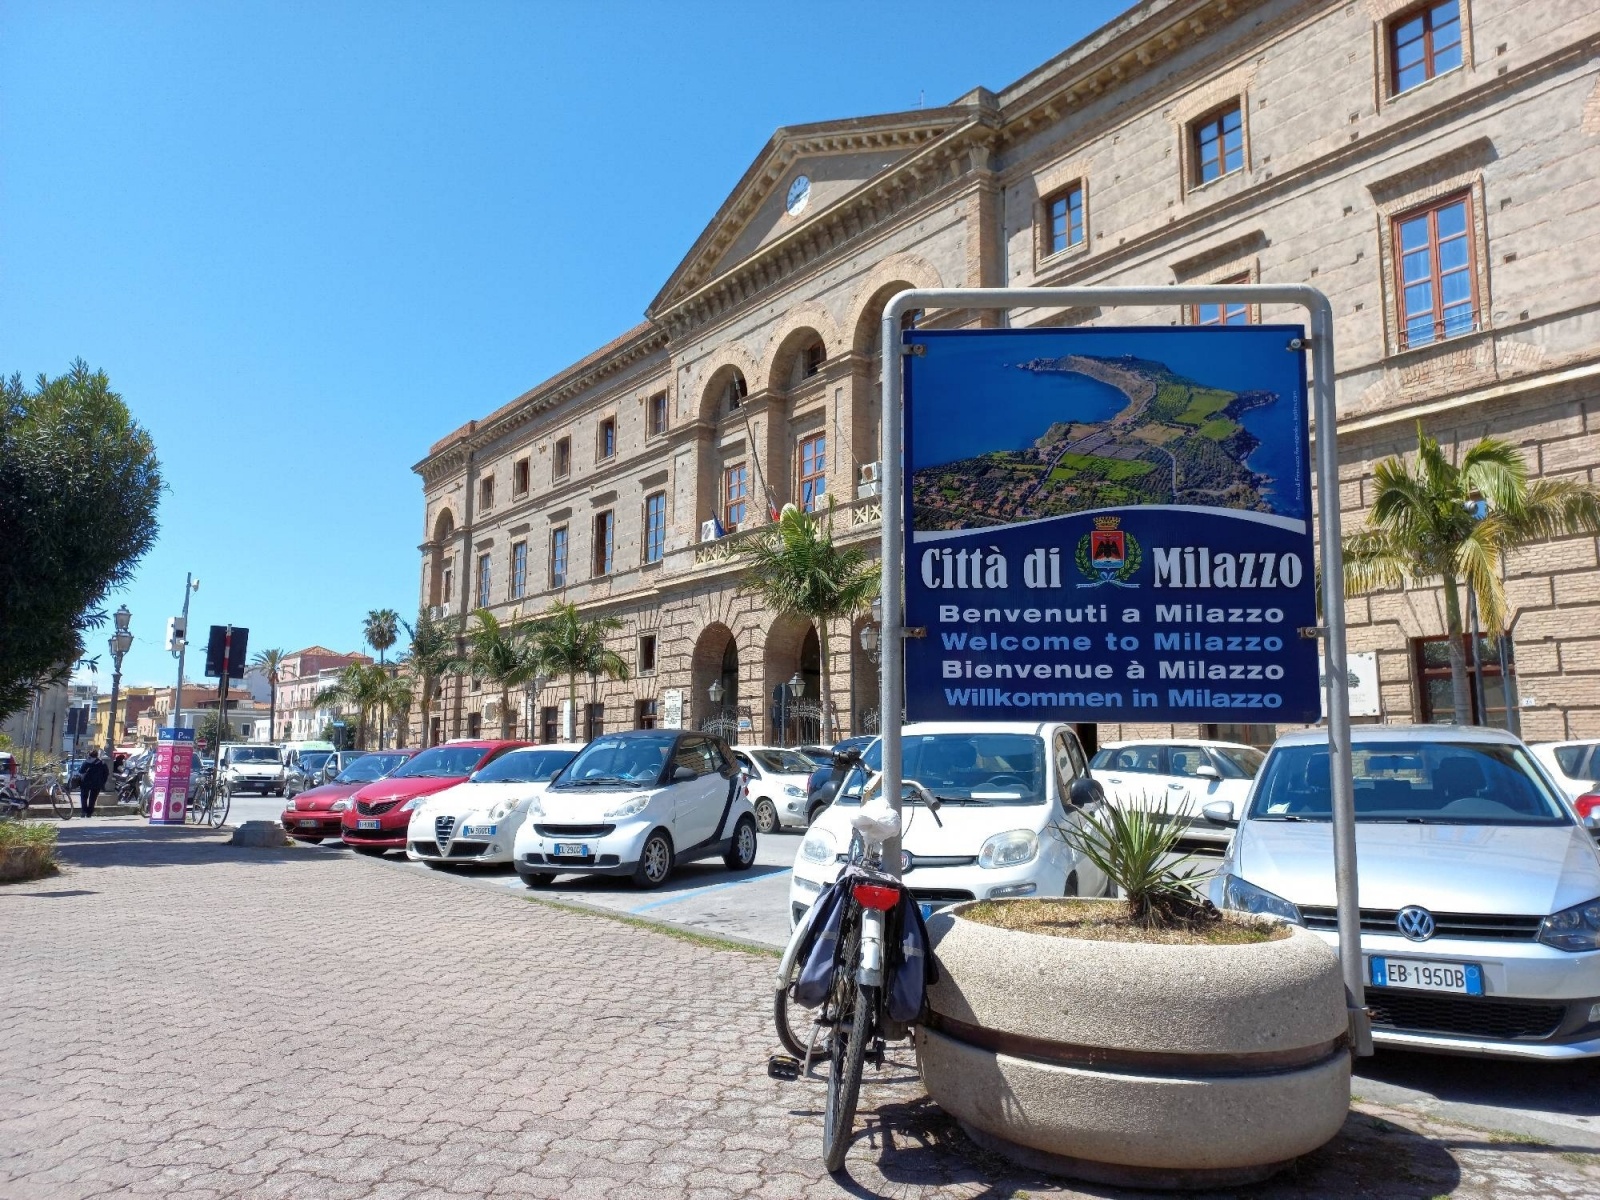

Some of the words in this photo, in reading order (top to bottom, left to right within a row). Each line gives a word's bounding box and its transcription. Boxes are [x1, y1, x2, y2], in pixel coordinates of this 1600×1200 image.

[921, 546, 1008, 589] Città
[1023, 547, 1062, 589] di
[1153, 546, 1303, 589] Milazzo
[939, 604, 1107, 623] Benvenuti
[1121, 608, 1140, 623] a
[1155, 604, 1284, 623] Milazzo
[941, 632, 1092, 651] Welcome
[1106, 632, 1139, 651] to
[1154, 632, 1283, 651] Milazzo
[942, 660, 1113, 679] Bienvenue
[1126, 660, 1145, 679] à
[1159, 660, 1284, 679] Milazzo
[944, 688, 1123, 707] Willkommen
[1132, 688, 1158, 707] in
[1168, 689, 1283, 708] Milazzo
[1387, 964, 1408, 982] EB
[1413, 966, 1465, 988] 195DB
